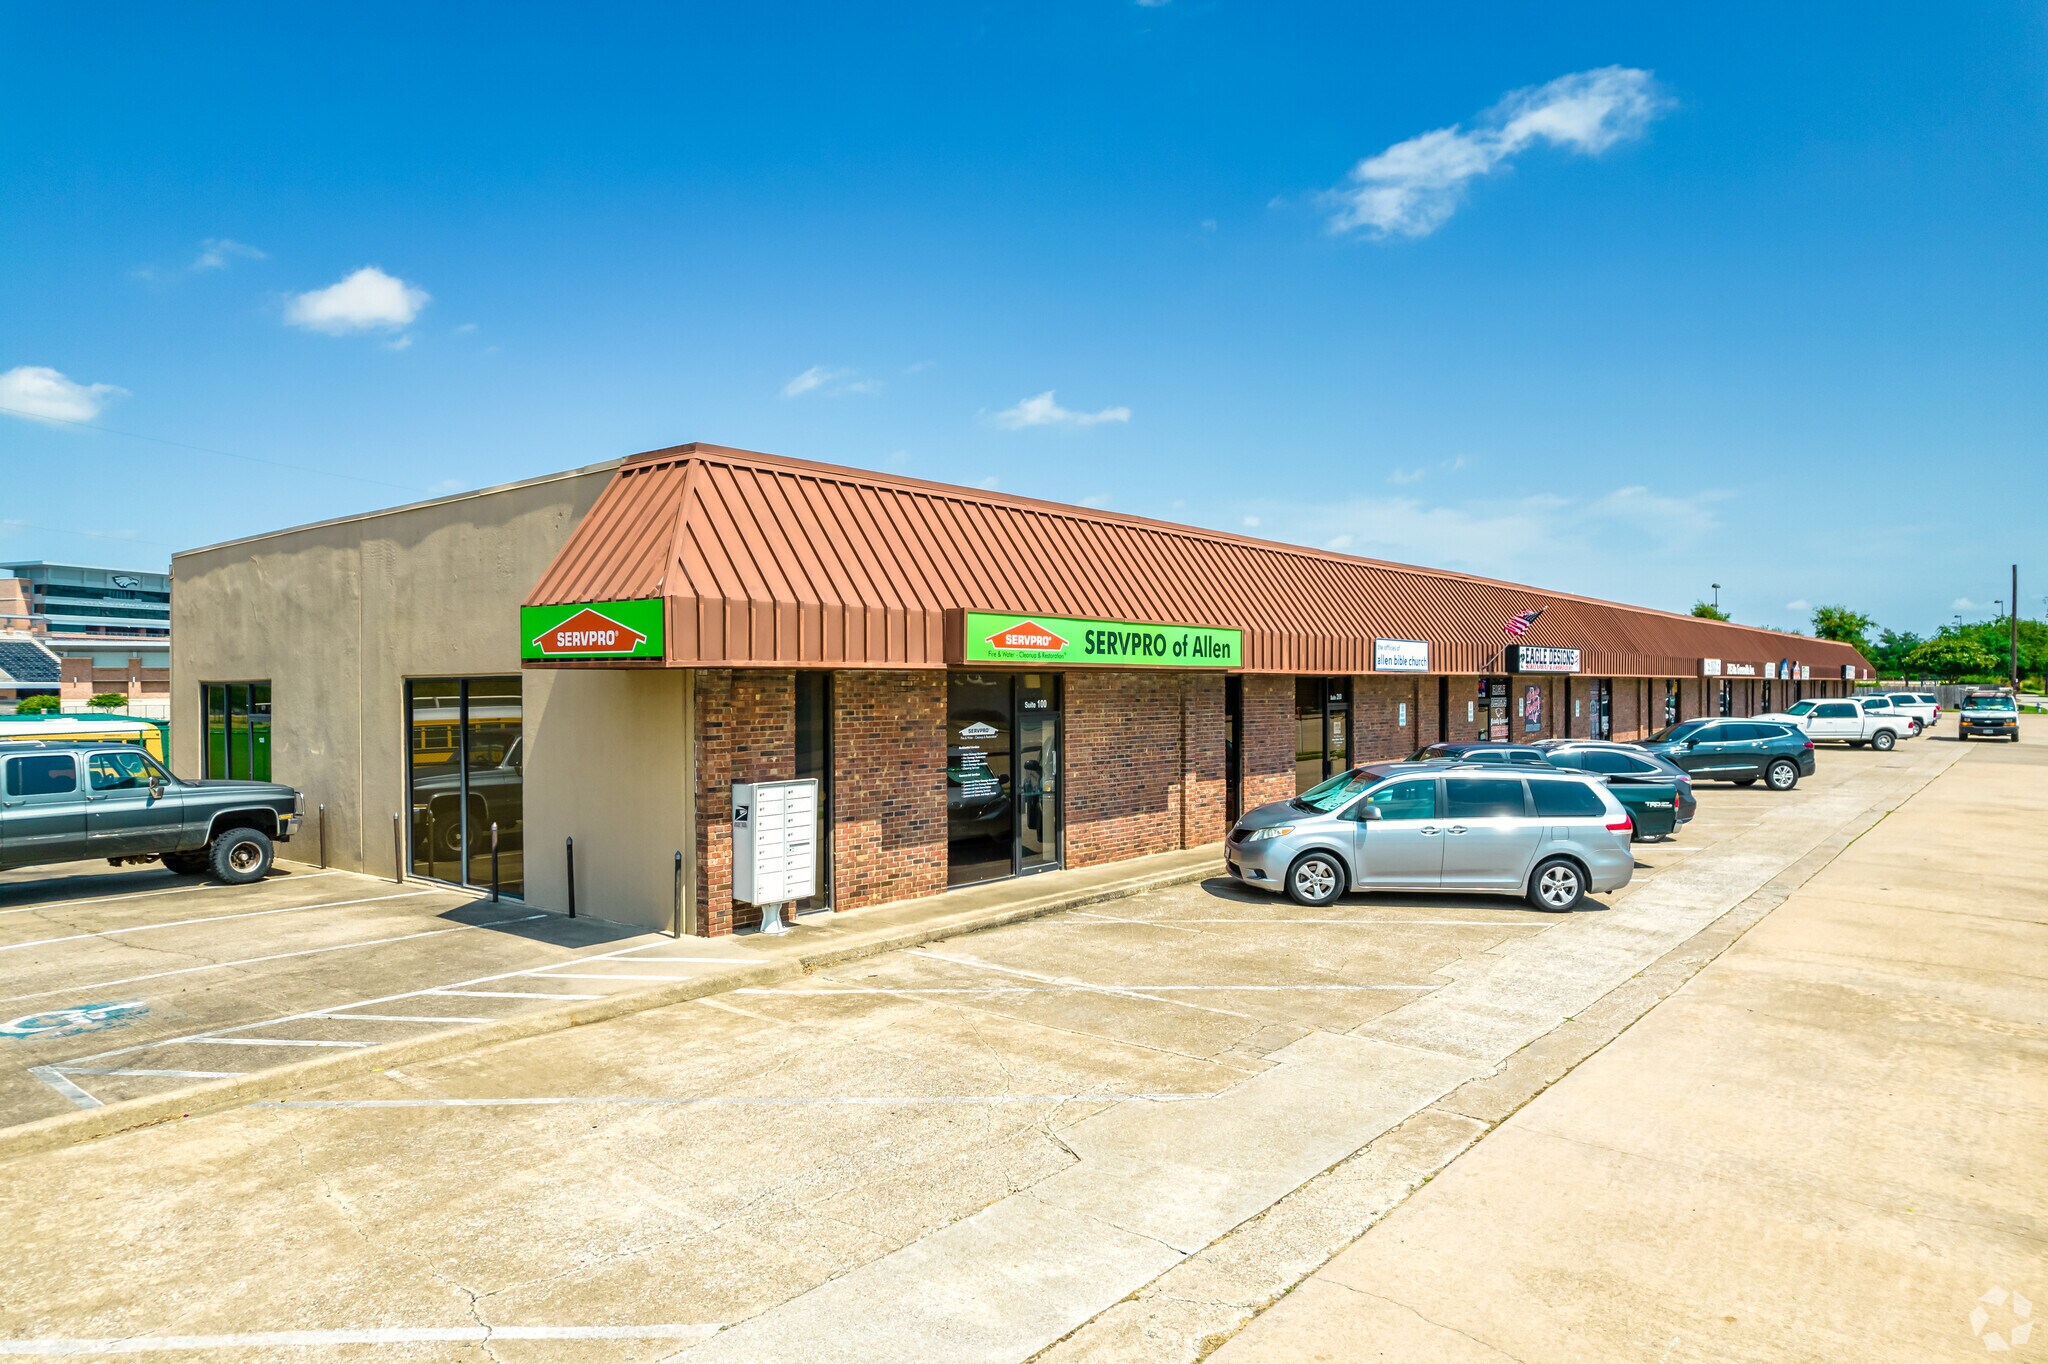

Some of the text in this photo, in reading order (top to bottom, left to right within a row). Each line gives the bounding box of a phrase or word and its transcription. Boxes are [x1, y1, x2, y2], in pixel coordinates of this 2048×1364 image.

[1084, 629, 1231, 658] SERVPRO of Allen
[1019, 651, 1037, 659] Cleanup
[1377, 654, 1427, 666] allen bible church
[1526, 648, 1575, 665] EAGLE DESIGNS
[1037, 699, 1048, 708] 100
